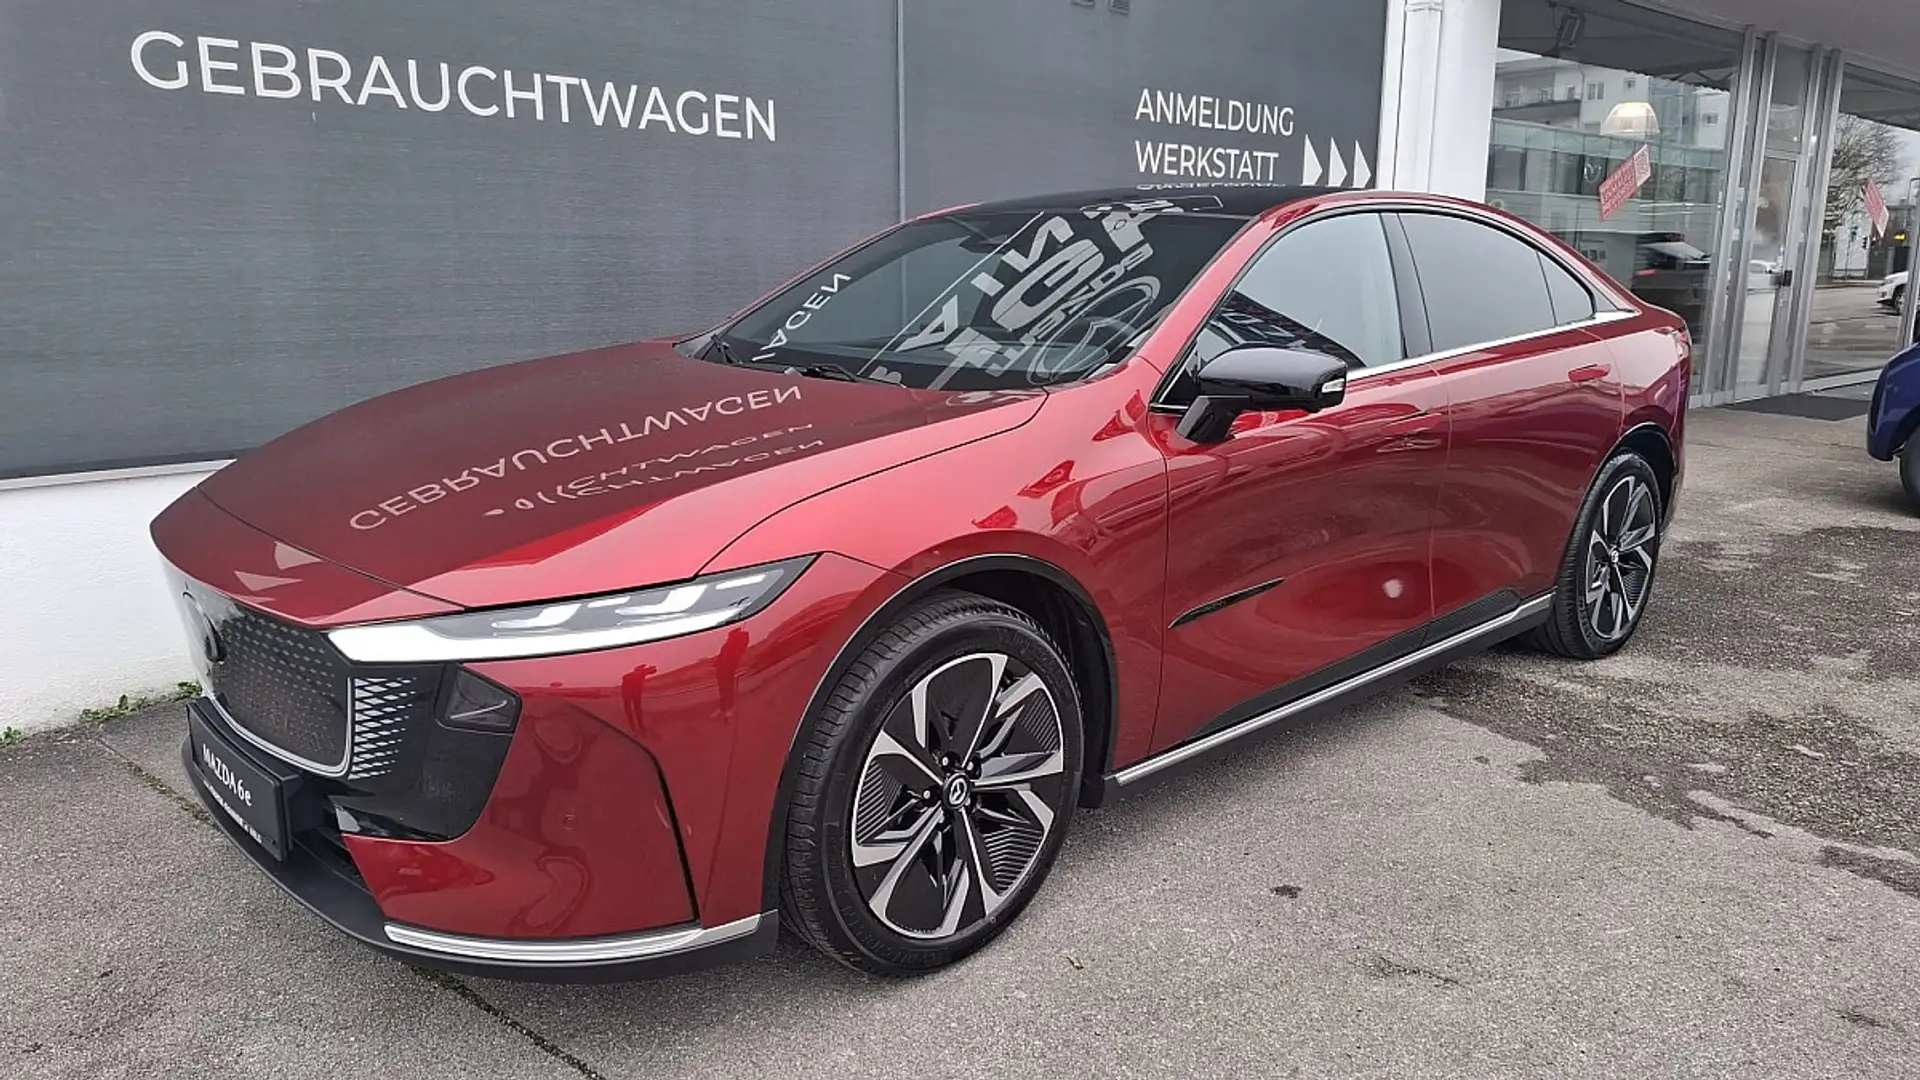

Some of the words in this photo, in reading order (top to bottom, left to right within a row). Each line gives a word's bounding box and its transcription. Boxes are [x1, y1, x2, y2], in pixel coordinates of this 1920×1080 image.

[130, 31, 776, 142] GEBRAUCHTWAGEN
[1135, 88, 1294, 136] ANMELDUNG
[1135, 140, 1280, 181] WERKSTATT
